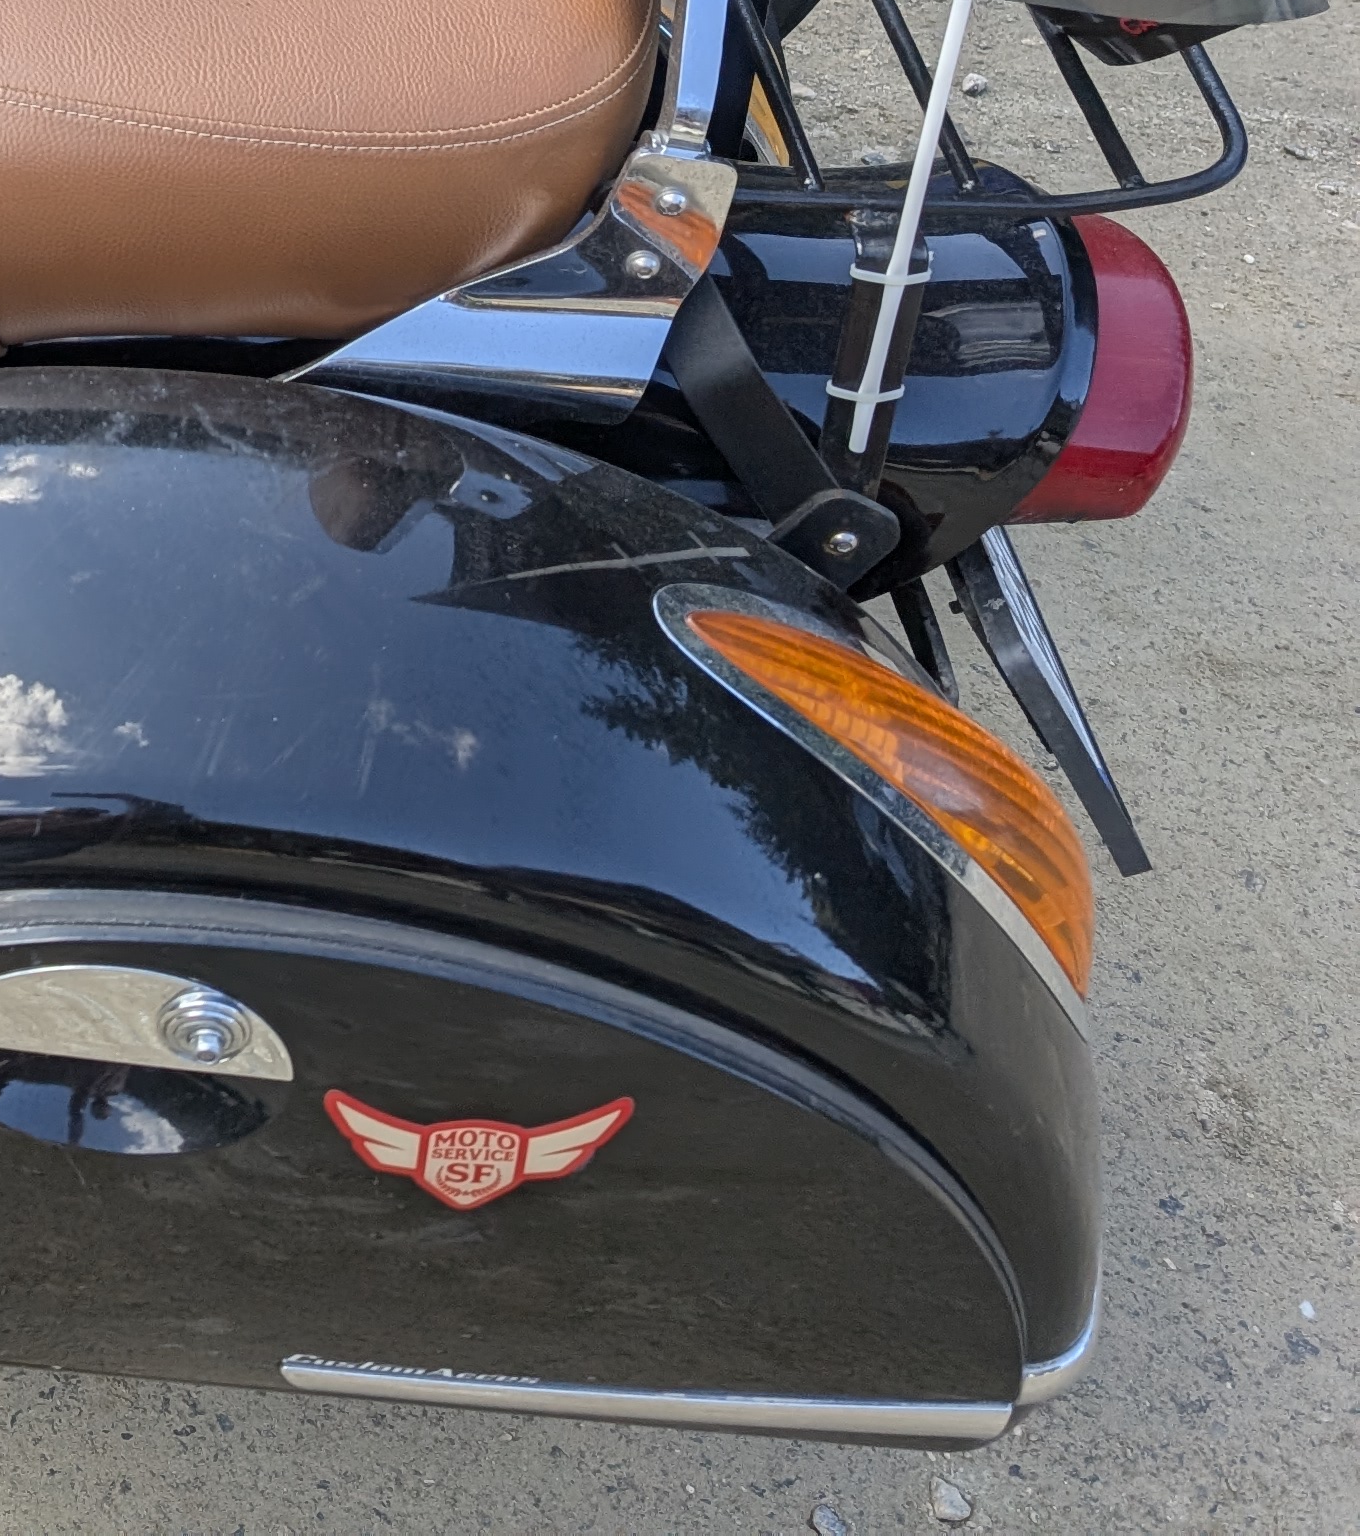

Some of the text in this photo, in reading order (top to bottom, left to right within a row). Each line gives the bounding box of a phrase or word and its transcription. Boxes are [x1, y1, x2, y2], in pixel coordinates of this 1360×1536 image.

[434, 1130, 516, 1150] MOTO
[431, 1148, 515, 1162] SERVICE
[444, 1162, 495, 1183] SF
